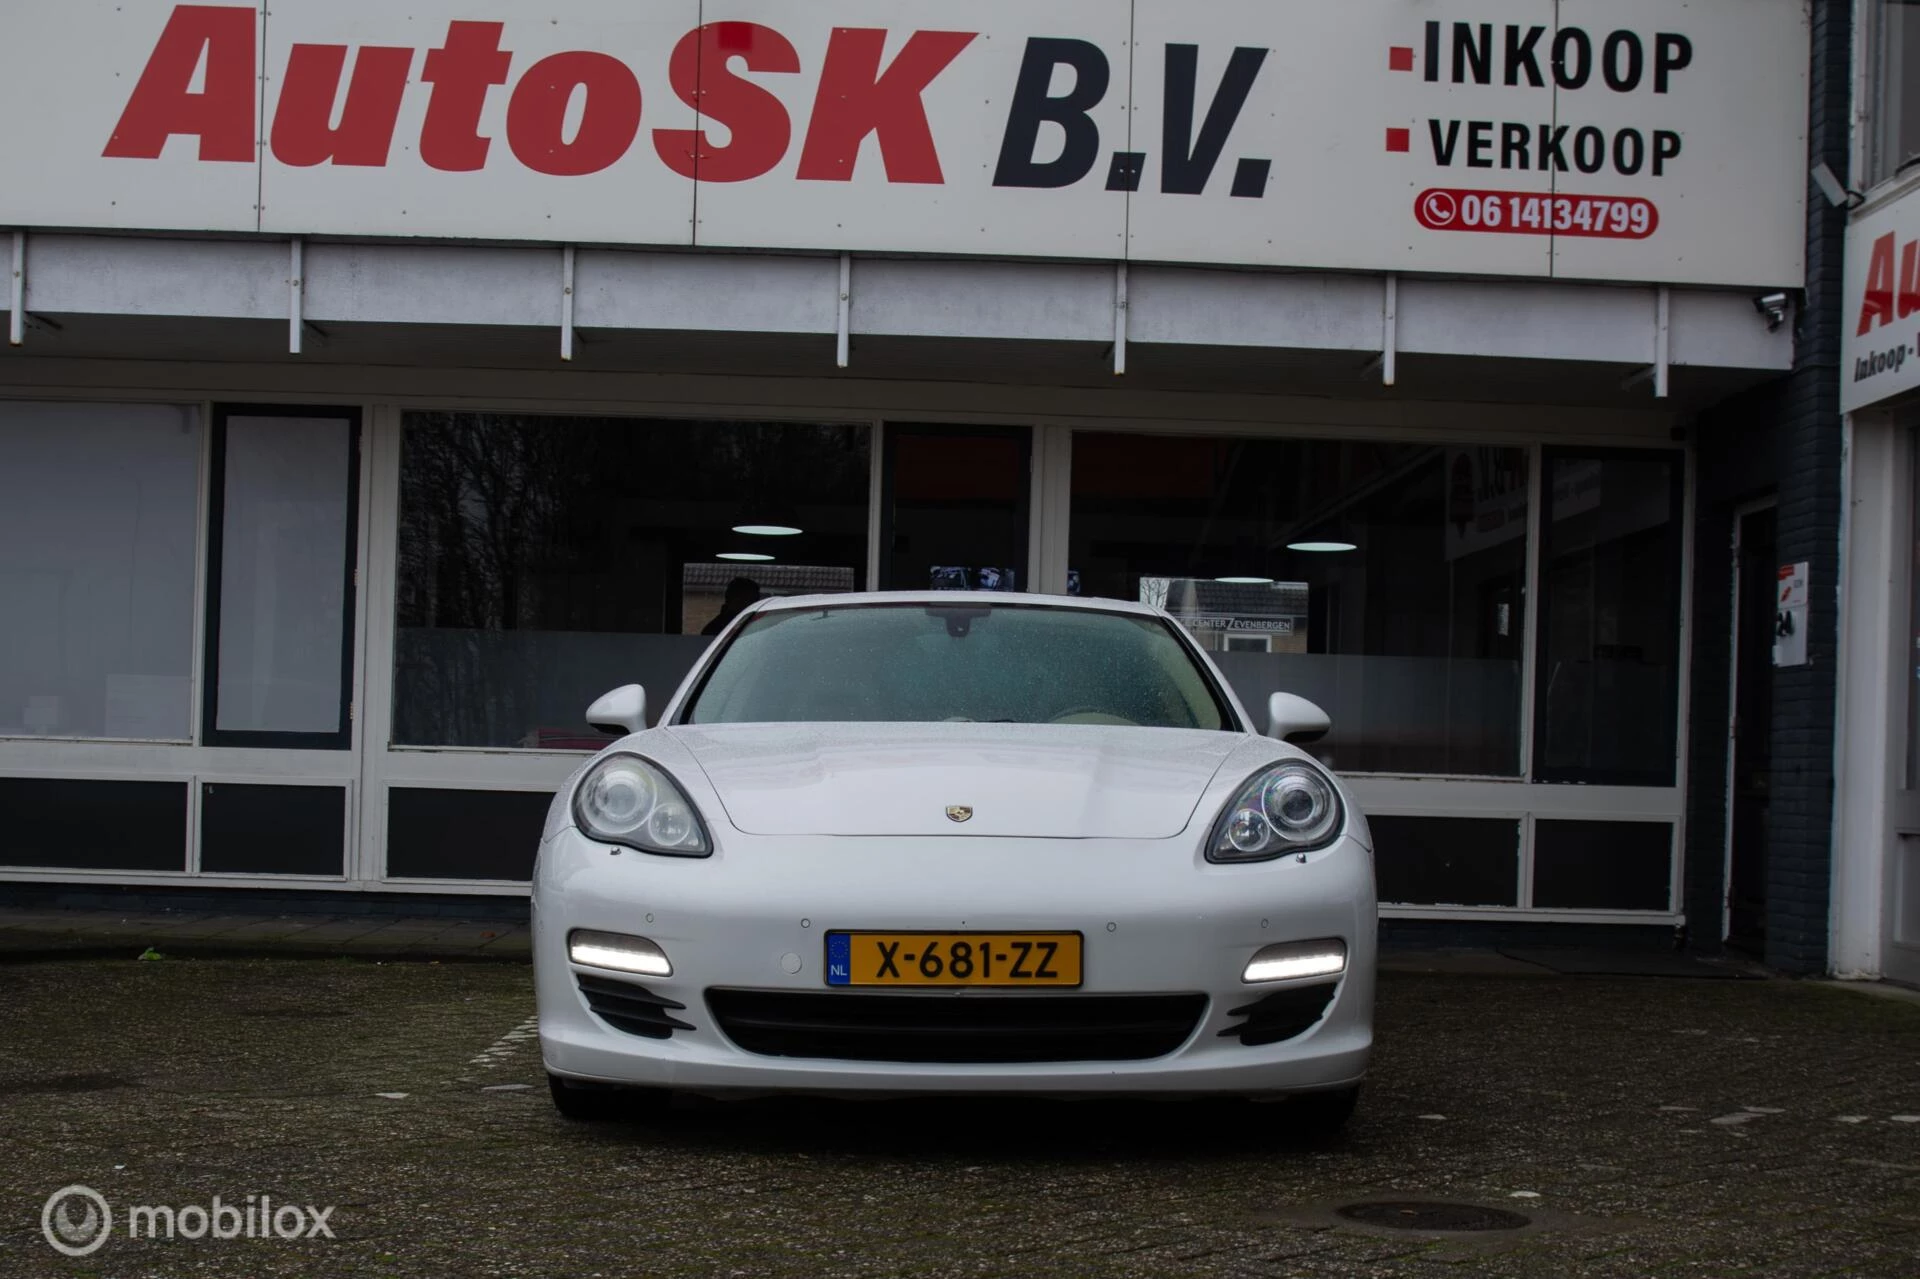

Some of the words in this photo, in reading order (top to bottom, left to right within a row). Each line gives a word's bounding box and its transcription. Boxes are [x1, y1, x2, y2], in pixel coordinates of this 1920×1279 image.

[1424, 21, 1693, 94] INKOOP
[101, 4, 980, 185] AutoSK
[992, 37, 1272, 198] B.V.
[1428, 119, 1682, 177] VERKOOP
[1461, 195, 1501, 227] 06
[1509, 197, 1649, 234] 14134799
[1854, 345, 1905, 382] Inkoop
[1226, 617, 1290, 630] ZEVENBERGEN
[830, 964, 848, 976] NL
[876, 942, 1059, 978] X-681-ZZ
